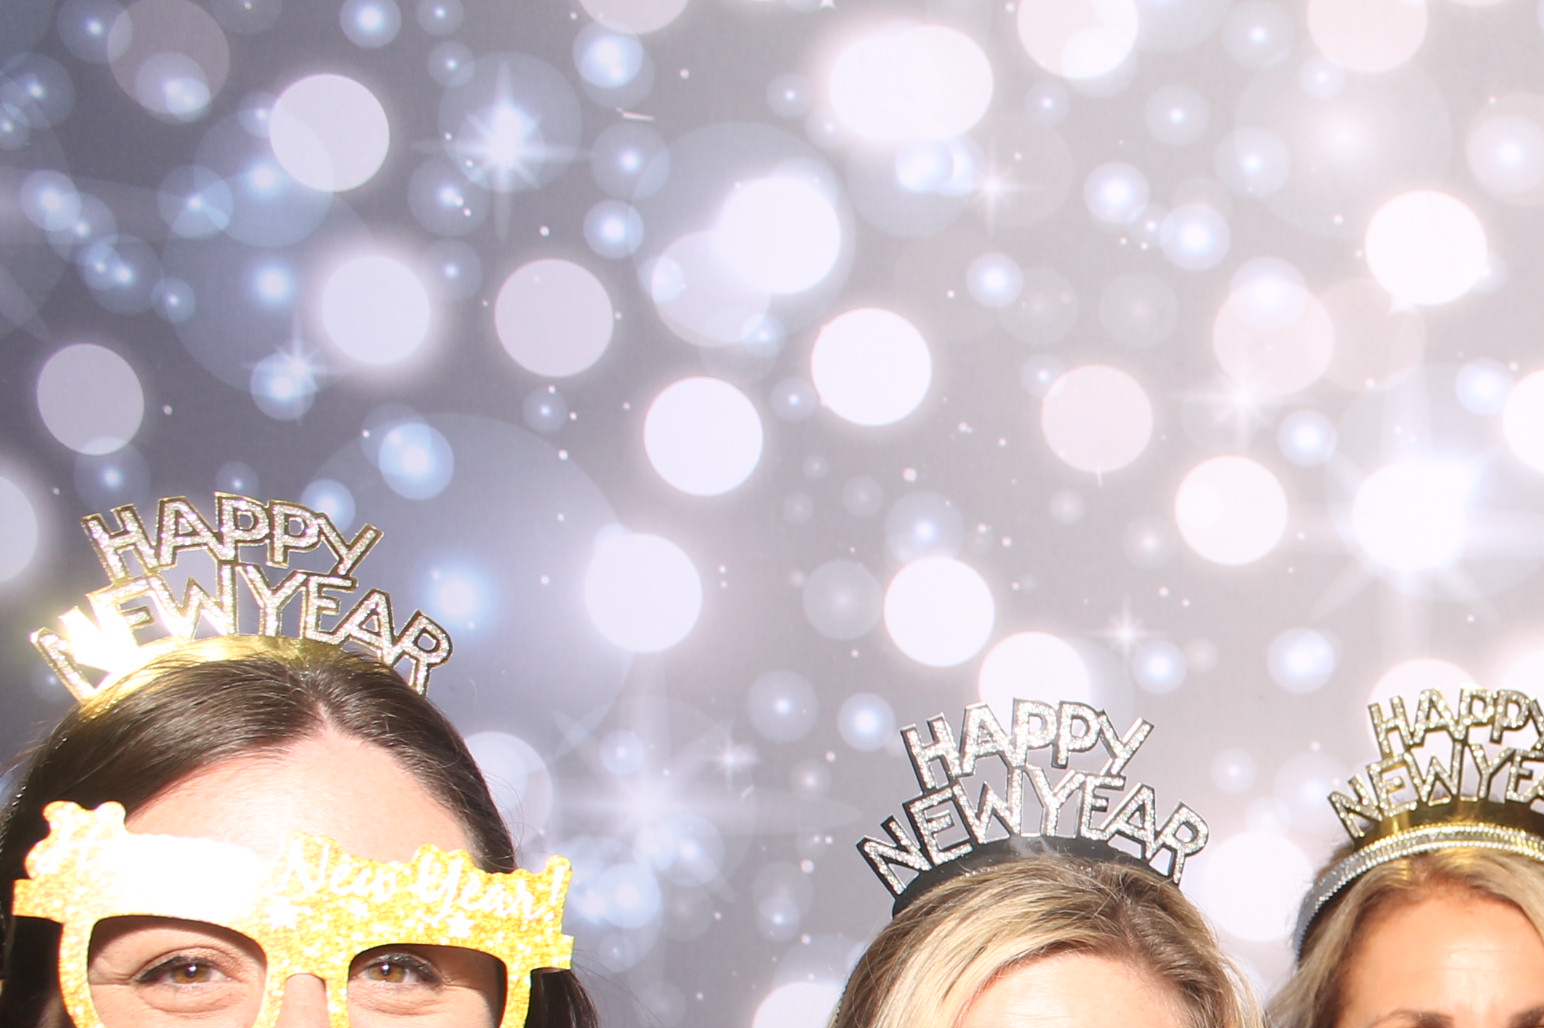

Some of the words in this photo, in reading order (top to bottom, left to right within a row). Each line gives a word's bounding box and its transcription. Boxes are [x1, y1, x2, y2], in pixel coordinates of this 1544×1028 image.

[82, 492, 384, 580] HAPPY
[900, 698, 1154, 792] HAPPY
[408, 853, 564, 924] Year!
